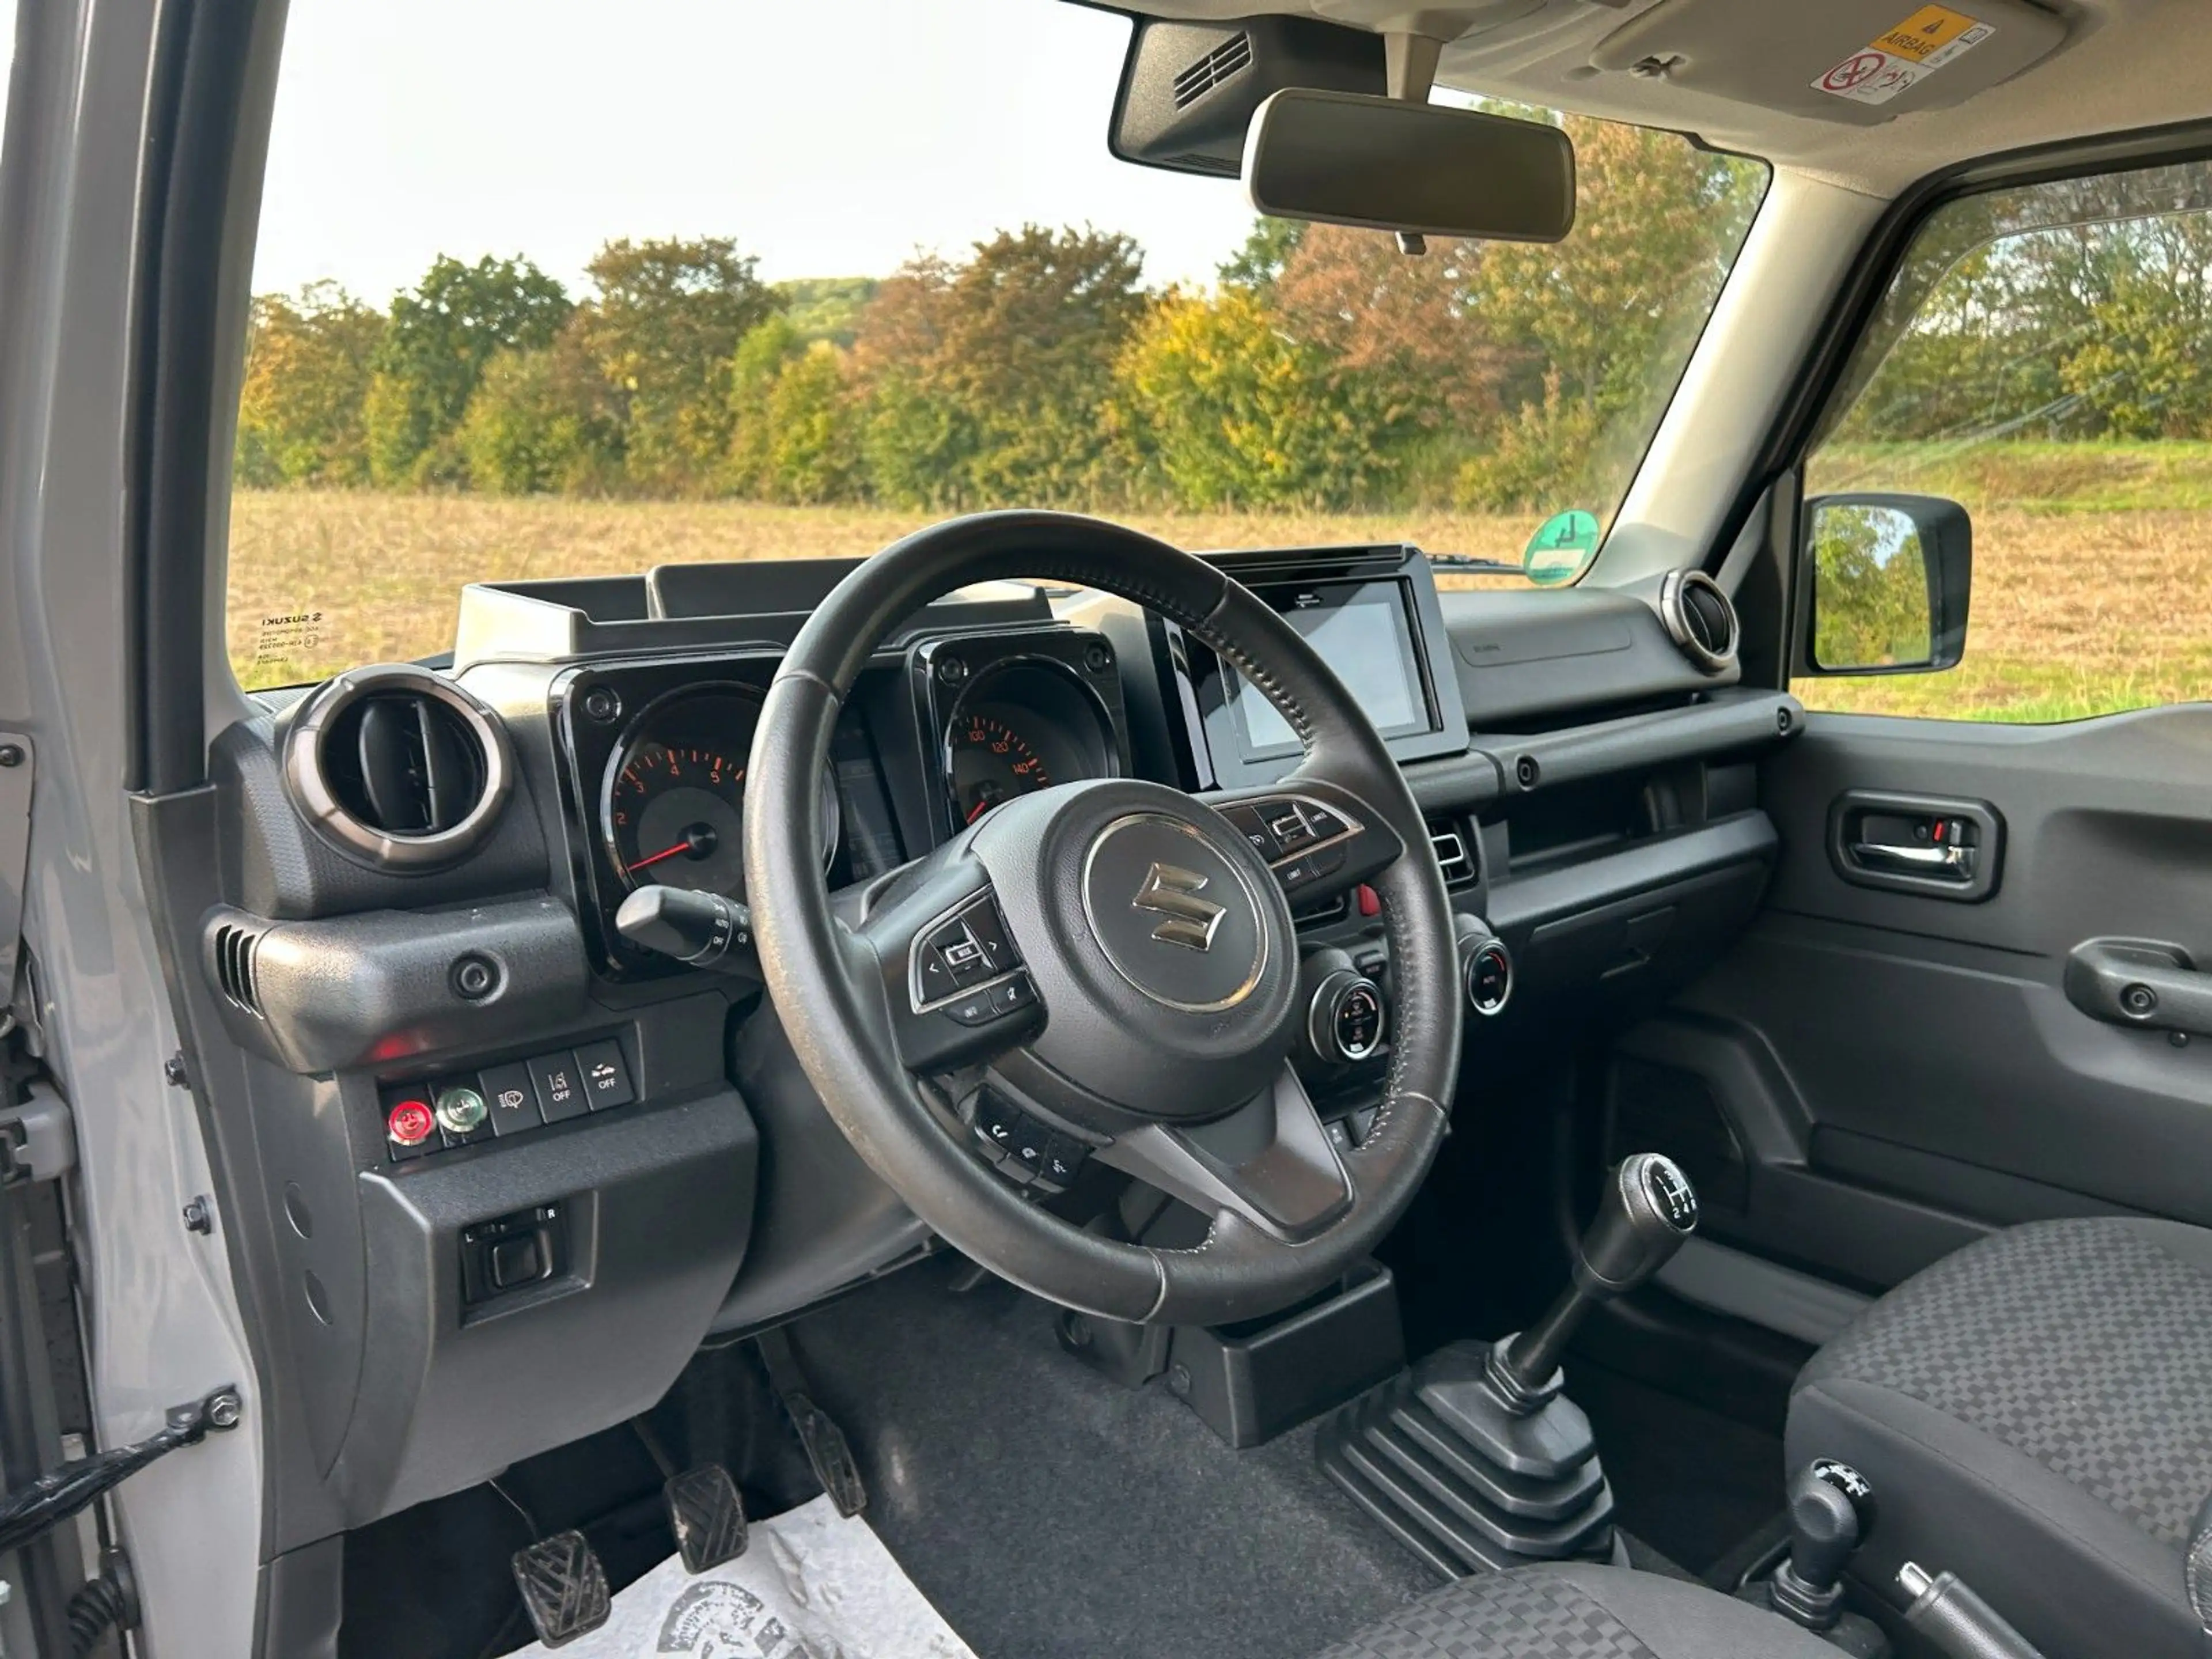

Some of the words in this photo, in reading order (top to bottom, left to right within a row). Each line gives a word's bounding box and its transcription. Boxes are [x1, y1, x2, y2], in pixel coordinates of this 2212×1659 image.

[1881, 31, 1936, 55] AIRBAG
[671, 764, 680, 776] 4
[710, 771, 720, 783] 5
[635, 781, 645, 793] 3
[616, 812, 627, 825] 2
[599, 1078, 616, 1089] OFF
[553, 1089, 570, 1101] OFF
[547, 1209, 555, 1219] R
[1672, 1207, 1681, 1219] 2
[465, 1233, 474, 1243] L
